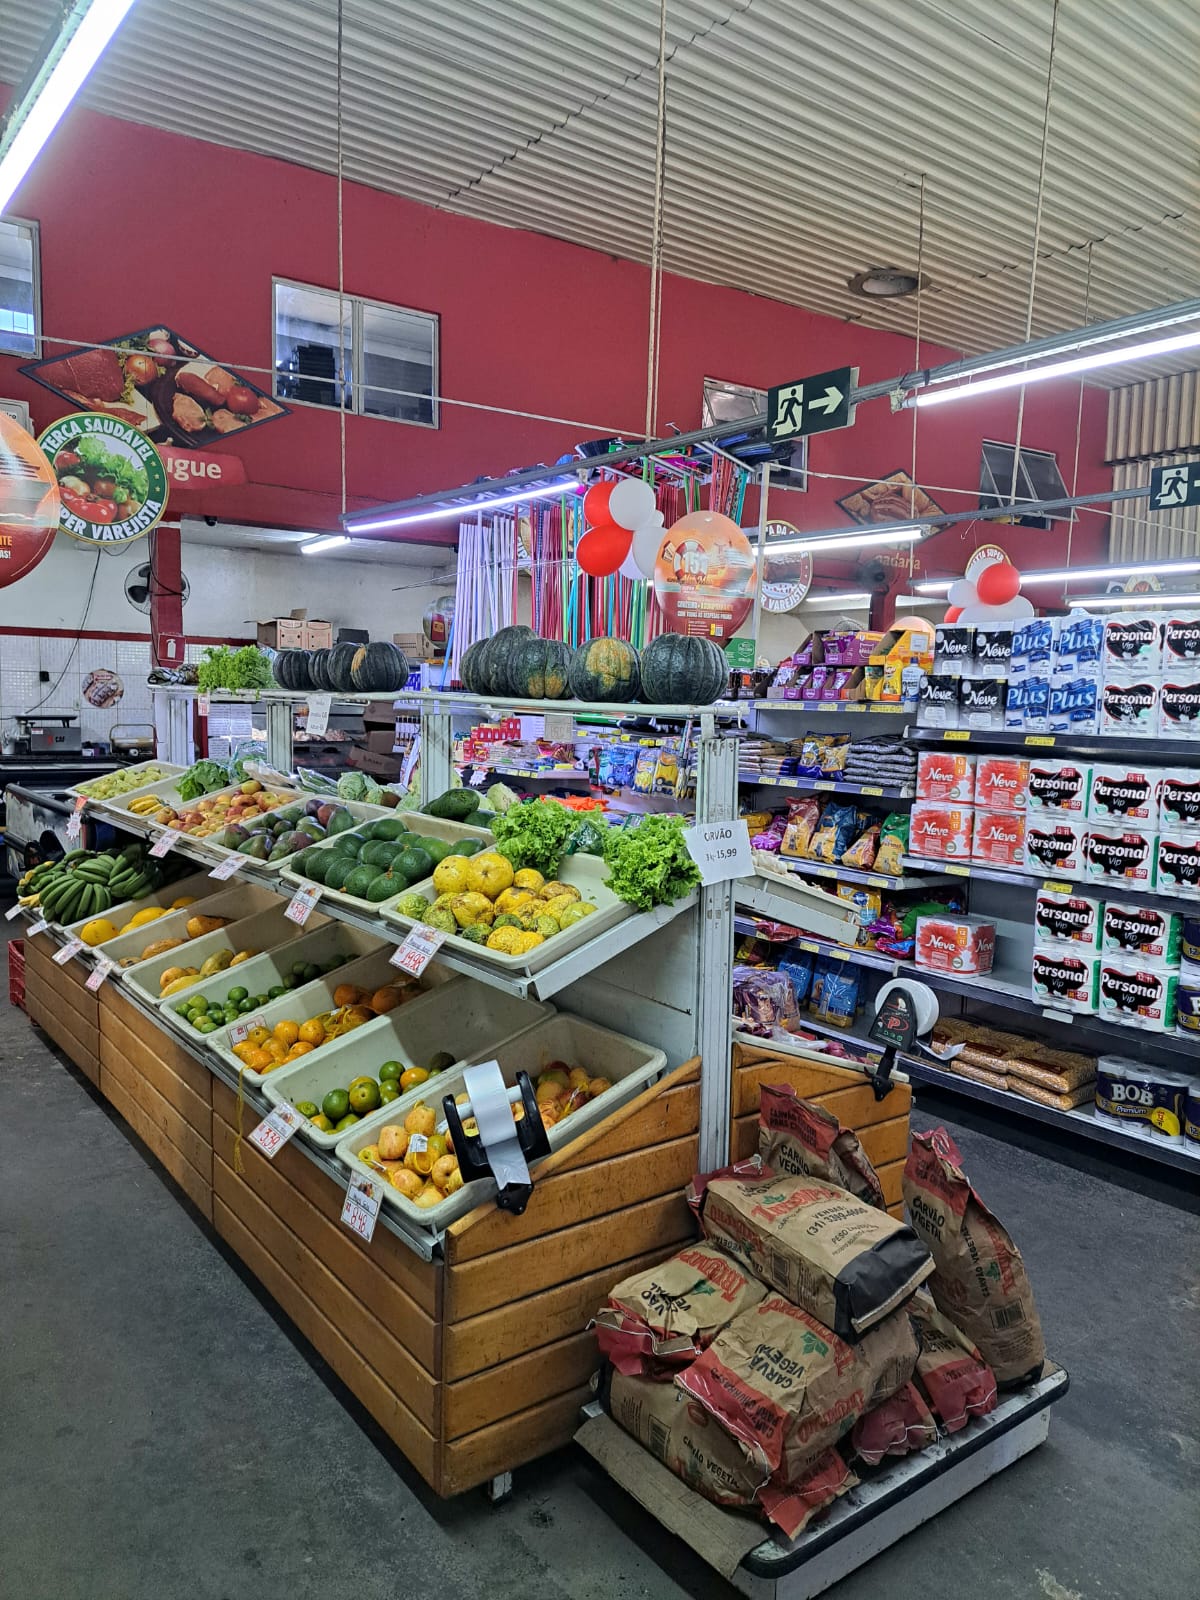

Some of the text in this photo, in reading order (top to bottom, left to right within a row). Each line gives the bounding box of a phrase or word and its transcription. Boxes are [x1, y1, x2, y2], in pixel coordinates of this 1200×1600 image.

[40, 418, 154, 461] TERÇA SAUDÁVEL
[91, 499, 162, 541] VAREJISTA
[769, 583, 807, 611] VAREJISTA
[1060, 627, 1100, 652] Plus
[1106, 627, 1157, 642] Personal
[938, 640, 968, 654] Neve
[979, 643, 1011, 657] Neve
[1012, 632, 1050, 655] Plus
[922, 685, 952, 700] Neve
[965, 690, 998, 705] Neve
[1007, 687, 1047, 708] Plus
[1049, 690, 1095, 711] Plus
[1103, 690, 1156, 705] Personal
[925, 767, 953, 782] Neve
[985, 773, 1017, 788] Neve
[1028, 774, 1083, 791] Personal
[1094, 781, 1151, 799] Personal
[1112, 798, 1126, 807] Vip
[1184, 803, 1199, 812] Vip
[704, 828, 732, 842] CRVÃO
[919, 822, 949, 836] Neve
[986, 826, 1017, 842] Neve
[1026, 833, 1078, 852] Personal
[1089, 837, 1149, 859] Personal
[1108, 857, 1122, 866] Vip
[1180, 866, 1195, 876] Vip
[1036, 902, 1094, 924] Personal
[1055, 920, 1068, 929] Vip
[1104, 912, 1165, 937] Personal
[925, 934, 956, 951] Neve
[1124, 932, 1138, 941] Vip
[1033, 961, 1088, 983] Personal
[1051, 978, 1065, 988] Vip
[1101, 973, 1163, 999] Personal
[1122, 994, 1136, 1004] Vip
[1111, 1083, 1154, 1107] BOB
[1116, 1105, 1148, 1114] Premium
[911, 1194, 946, 1228] CARVÃO
[831, 1228, 849, 1245] PESO
[748, 1352, 793, 1389] CARVÃ
